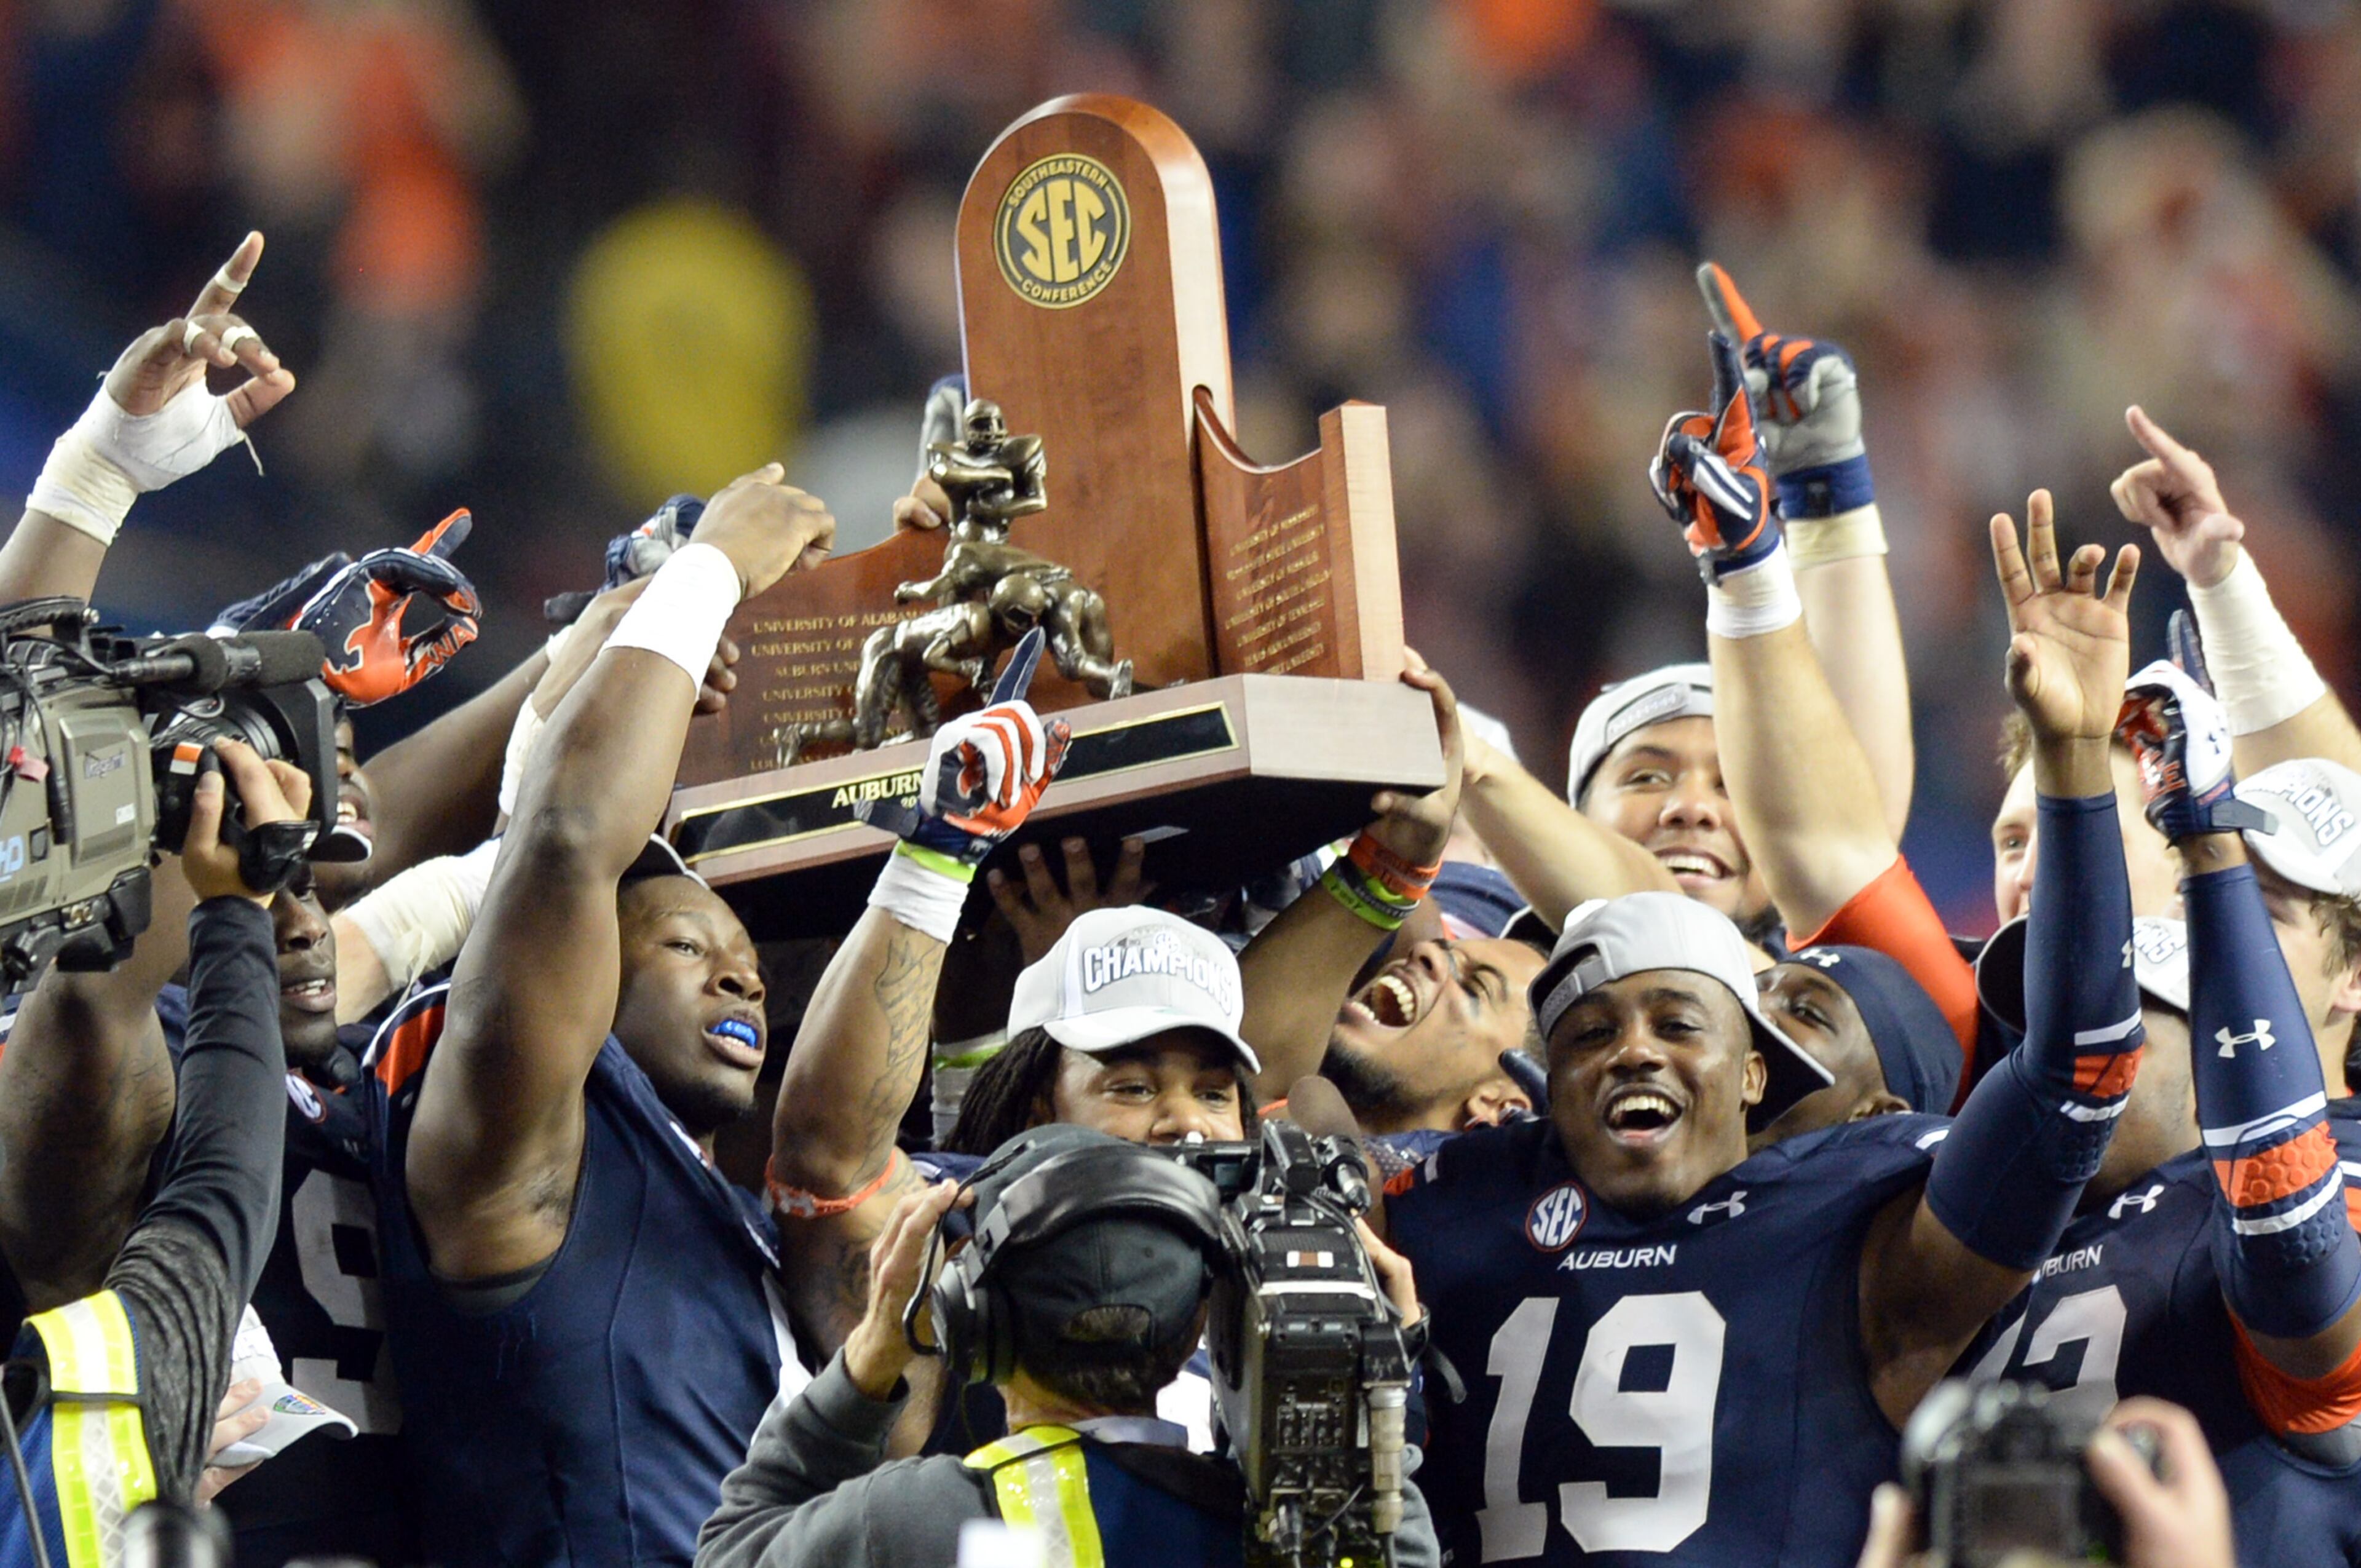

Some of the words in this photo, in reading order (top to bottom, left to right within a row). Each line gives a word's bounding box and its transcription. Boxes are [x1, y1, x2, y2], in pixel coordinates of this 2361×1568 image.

[1008, 160, 1109, 208] SOUTHEASTERN
[1016, 179, 1107, 283] SEC
[1021, 259, 1112, 301] CONFERENCE
[754, 617, 834, 634] UNIVERSITY
[839, 614, 856, 628] OF
[751, 639, 832, 657] UNIVERSITY
[836, 638, 855, 652] OF
[763, 685, 847, 702] UNIVERSITY
[764, 707, 848, 724] UNIVERSITY
[831, 772, 922, 809] AUBURN
[1083, 946, 1233, 1016] CHAMPIONS
[1532, 1186, 1583, 1247] SEC
[1557, 1244, 1677, 1272] AUBURN
[1475, 1291, 1727, 1564] 19
